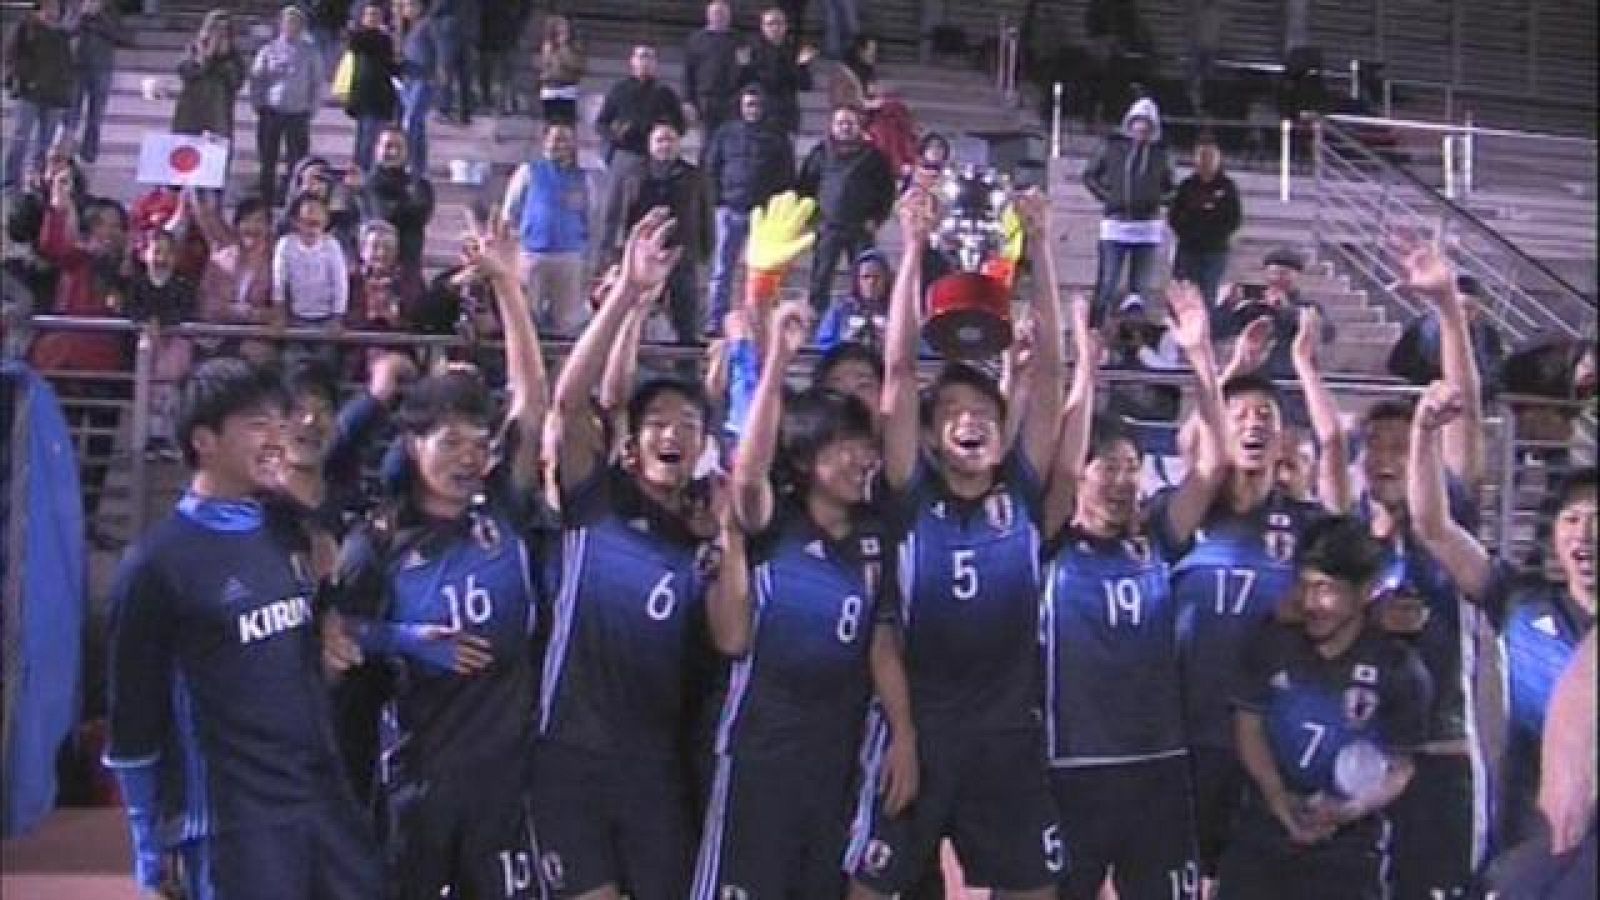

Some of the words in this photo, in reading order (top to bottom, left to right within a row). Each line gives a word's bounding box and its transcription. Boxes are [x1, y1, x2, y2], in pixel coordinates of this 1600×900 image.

[647, 570, 676, 621] 6
[951, 550, 979, 599] 5
[1214, 569, 1256, 614] 17
[440, 575, 491, 632] 16
[837, 595, 861, 643] 8
[1104, 578, 1141, 626] 19
[1299, 723, 1326, 768] 7
[1042, 824, 1063, 872] 5
